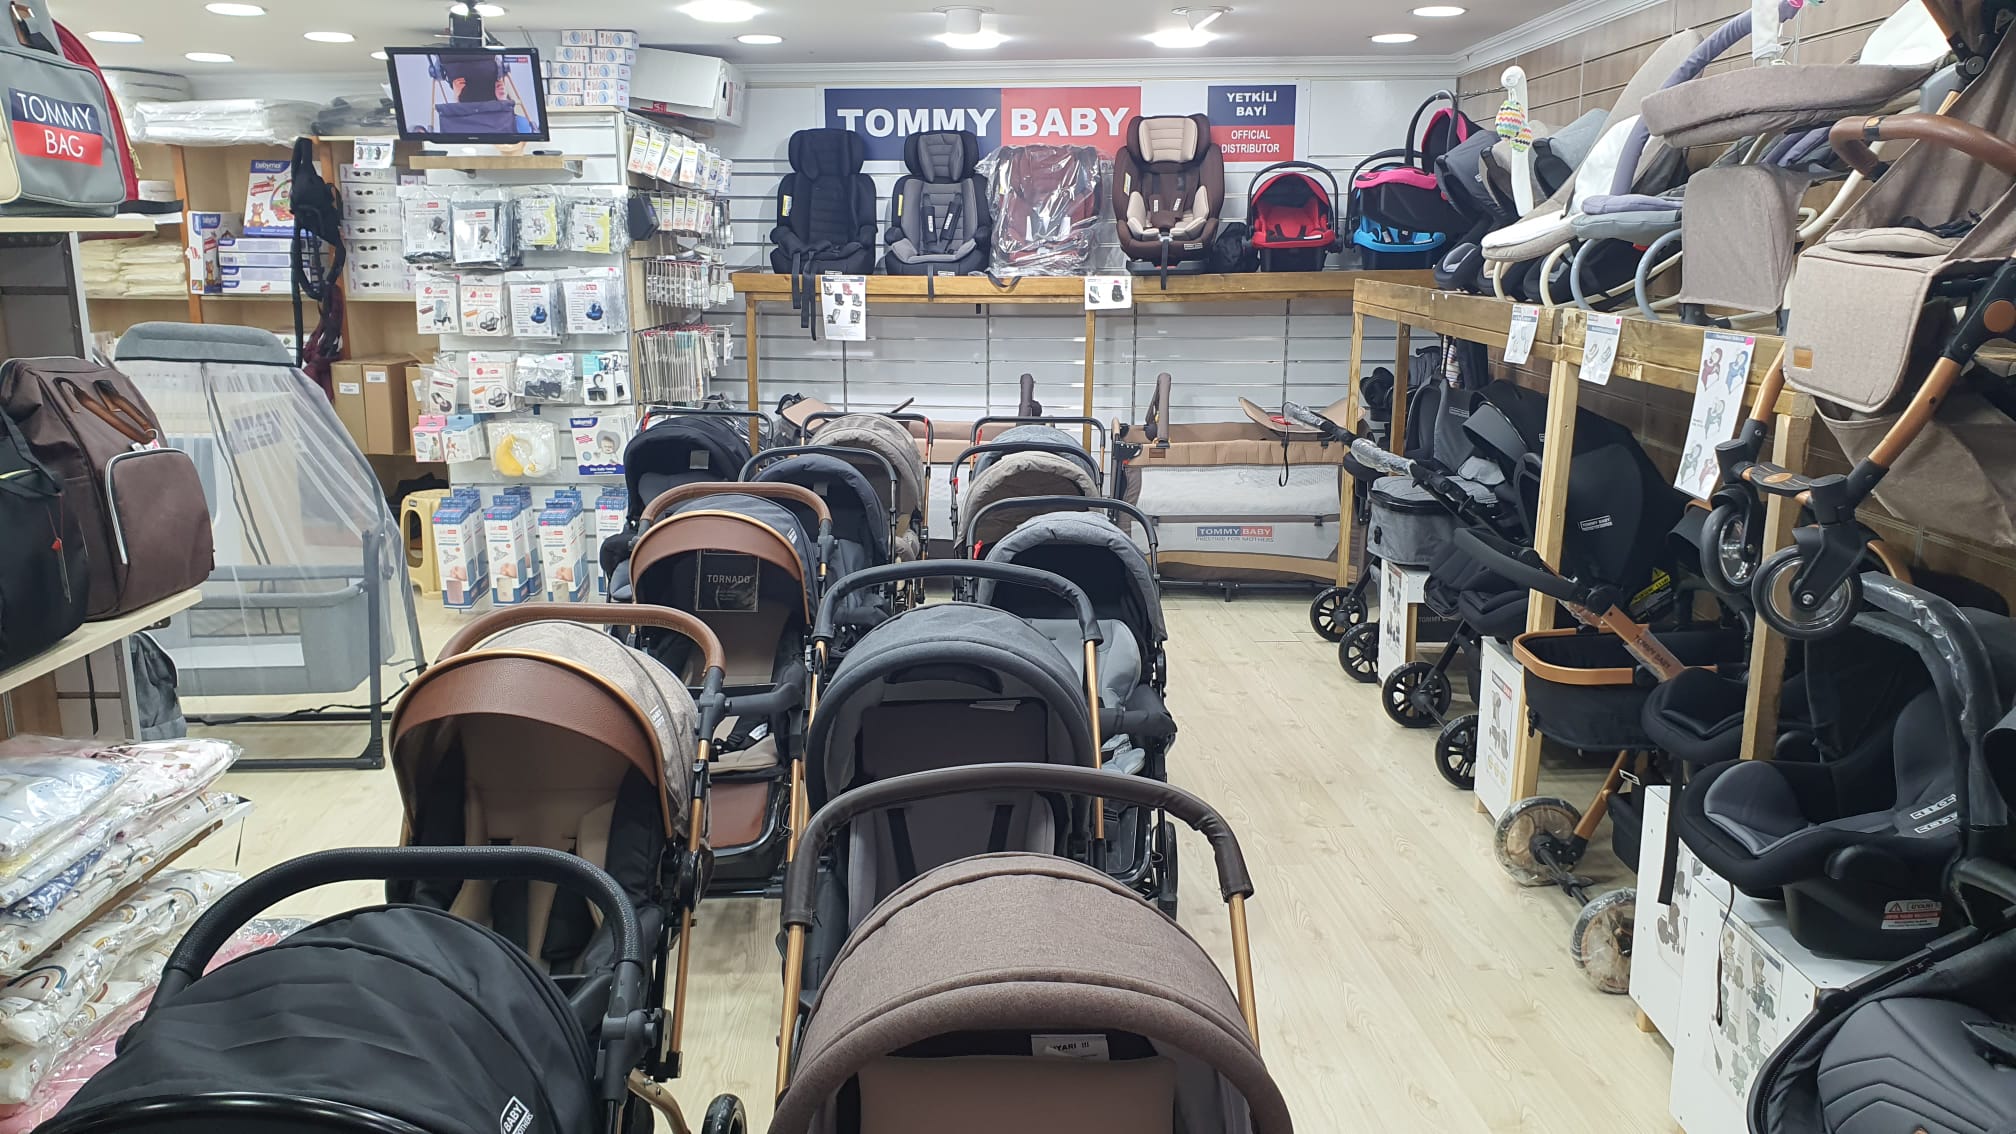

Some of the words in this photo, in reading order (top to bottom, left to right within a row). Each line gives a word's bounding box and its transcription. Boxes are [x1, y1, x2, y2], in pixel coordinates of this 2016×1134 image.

[1227, 90, 1277, 103] YETKİLİ
[16, 92, 92, 131] TOMMY
[1236, 104, 1267, 117] BAYİ
[836, 108, 997, 138] TOMMY
[1011, 107, 1130, 137] BABY
[1231, 129, 1271, 140] OFFICIAL
[44, 129, 84, 158] BAG
[1221, 143, 1280, 154] DISTRIBUTOR
[1242, 528, 1272, 536] BABY
[707, 574, 750, 584] TORNADO
[503, 1103, 523, 1133] BABY
